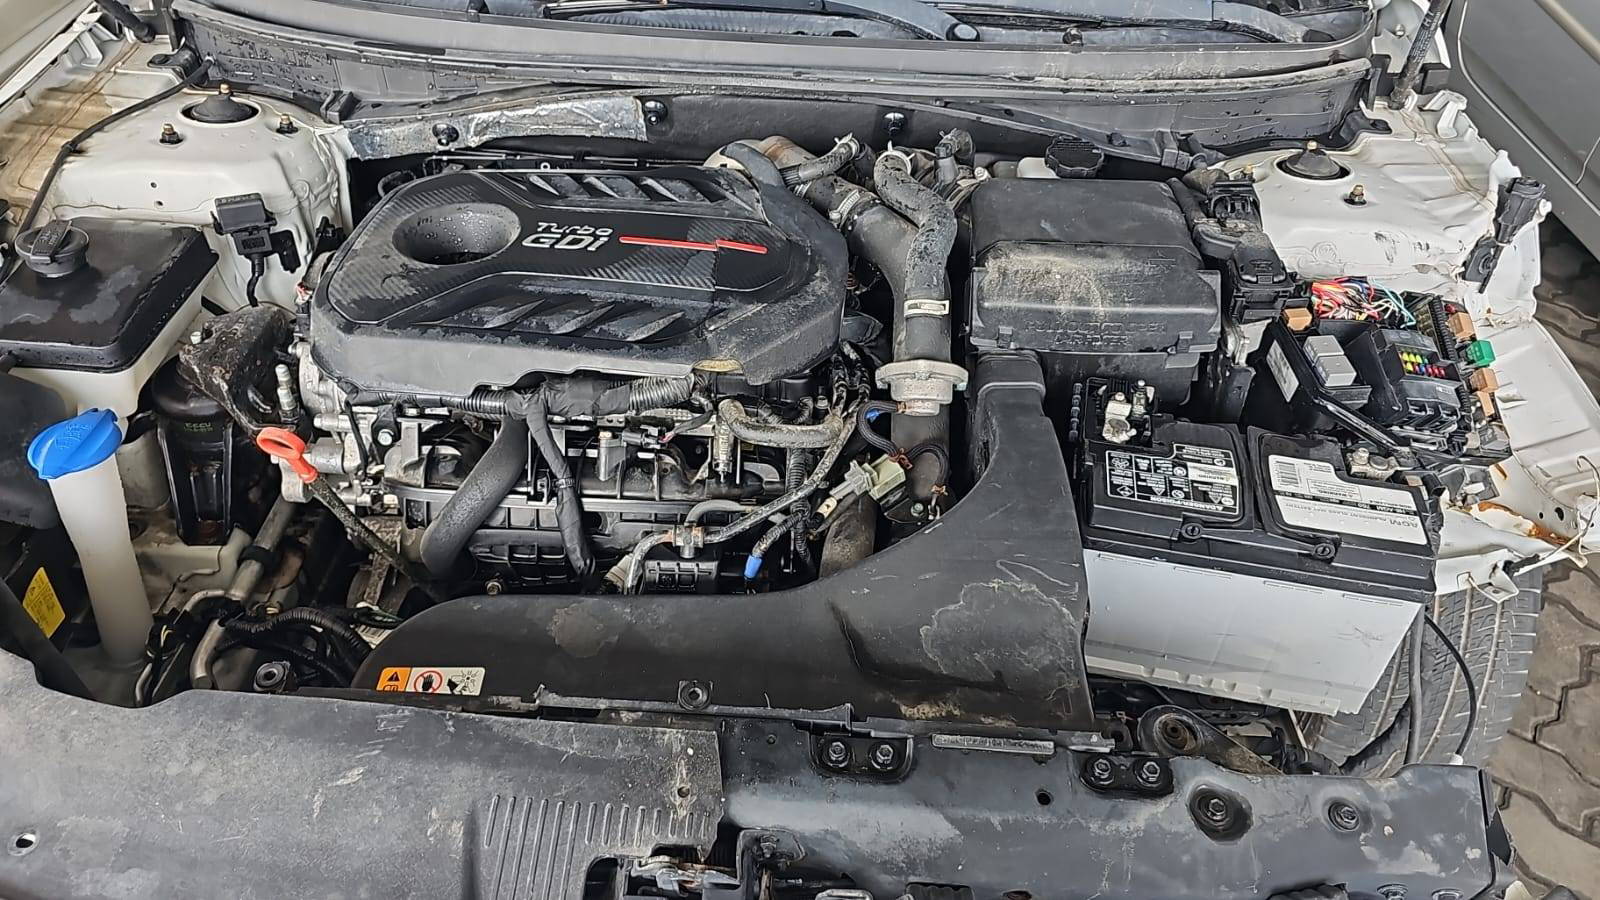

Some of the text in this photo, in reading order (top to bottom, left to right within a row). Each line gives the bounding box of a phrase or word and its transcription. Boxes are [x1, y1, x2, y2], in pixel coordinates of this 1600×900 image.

[537, 222, 613, 236] Turbo
[521, 232, 610, 251] GDi
[1389, 519, 1418, 528] AGM
